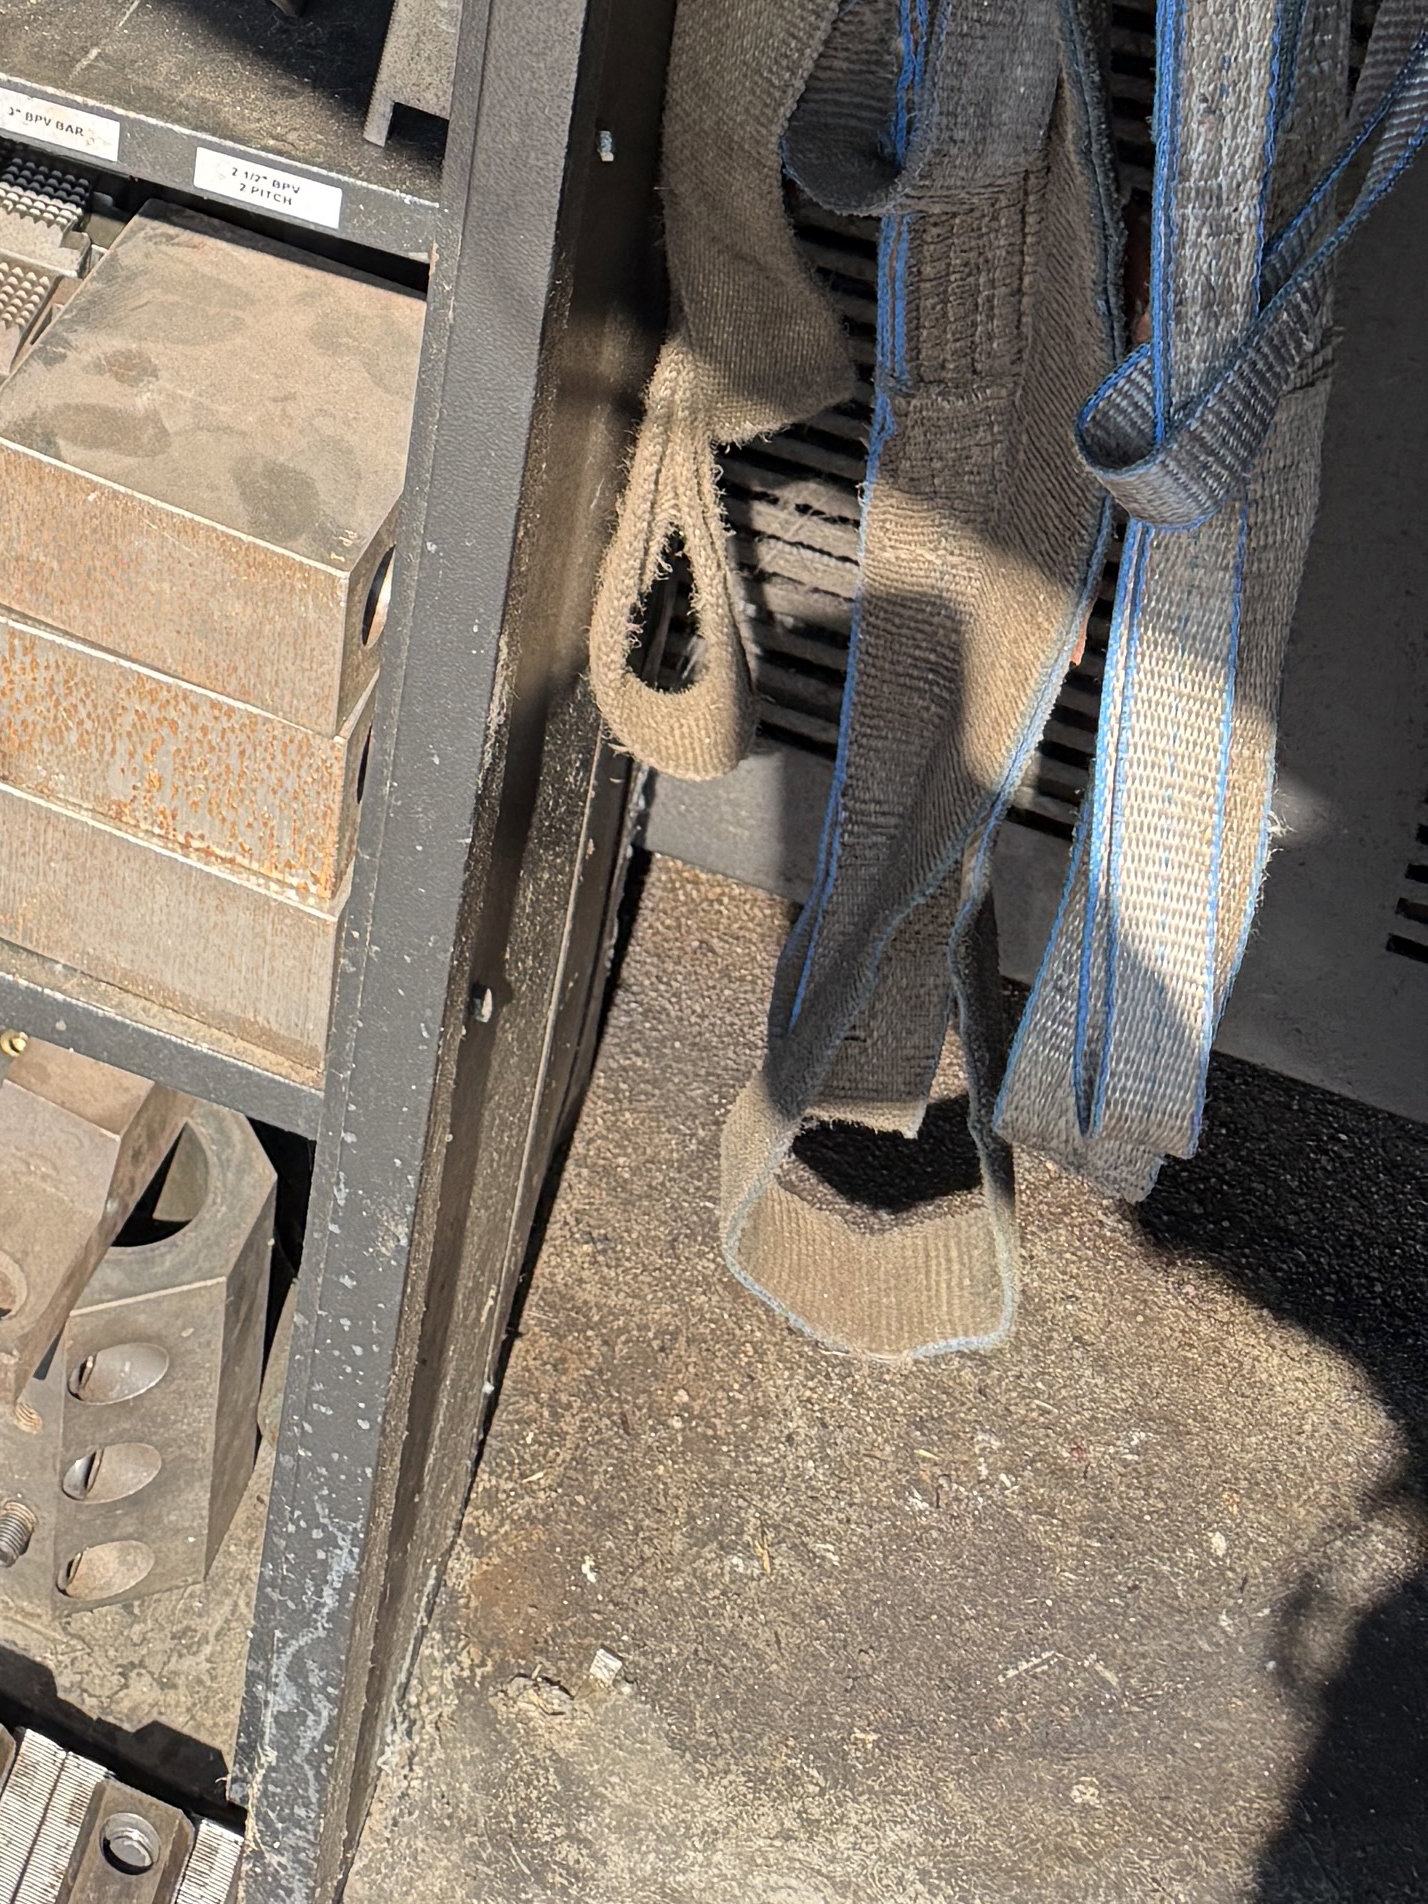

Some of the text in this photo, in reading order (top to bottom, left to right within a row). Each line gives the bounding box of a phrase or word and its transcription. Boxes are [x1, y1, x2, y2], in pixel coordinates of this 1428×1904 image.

[25, 112, 52, 126] BPV
[55, 120, 85, 137] BAR
[251, 186, 293, 206] PITCH
[272, 179, 301, 194] BPV
